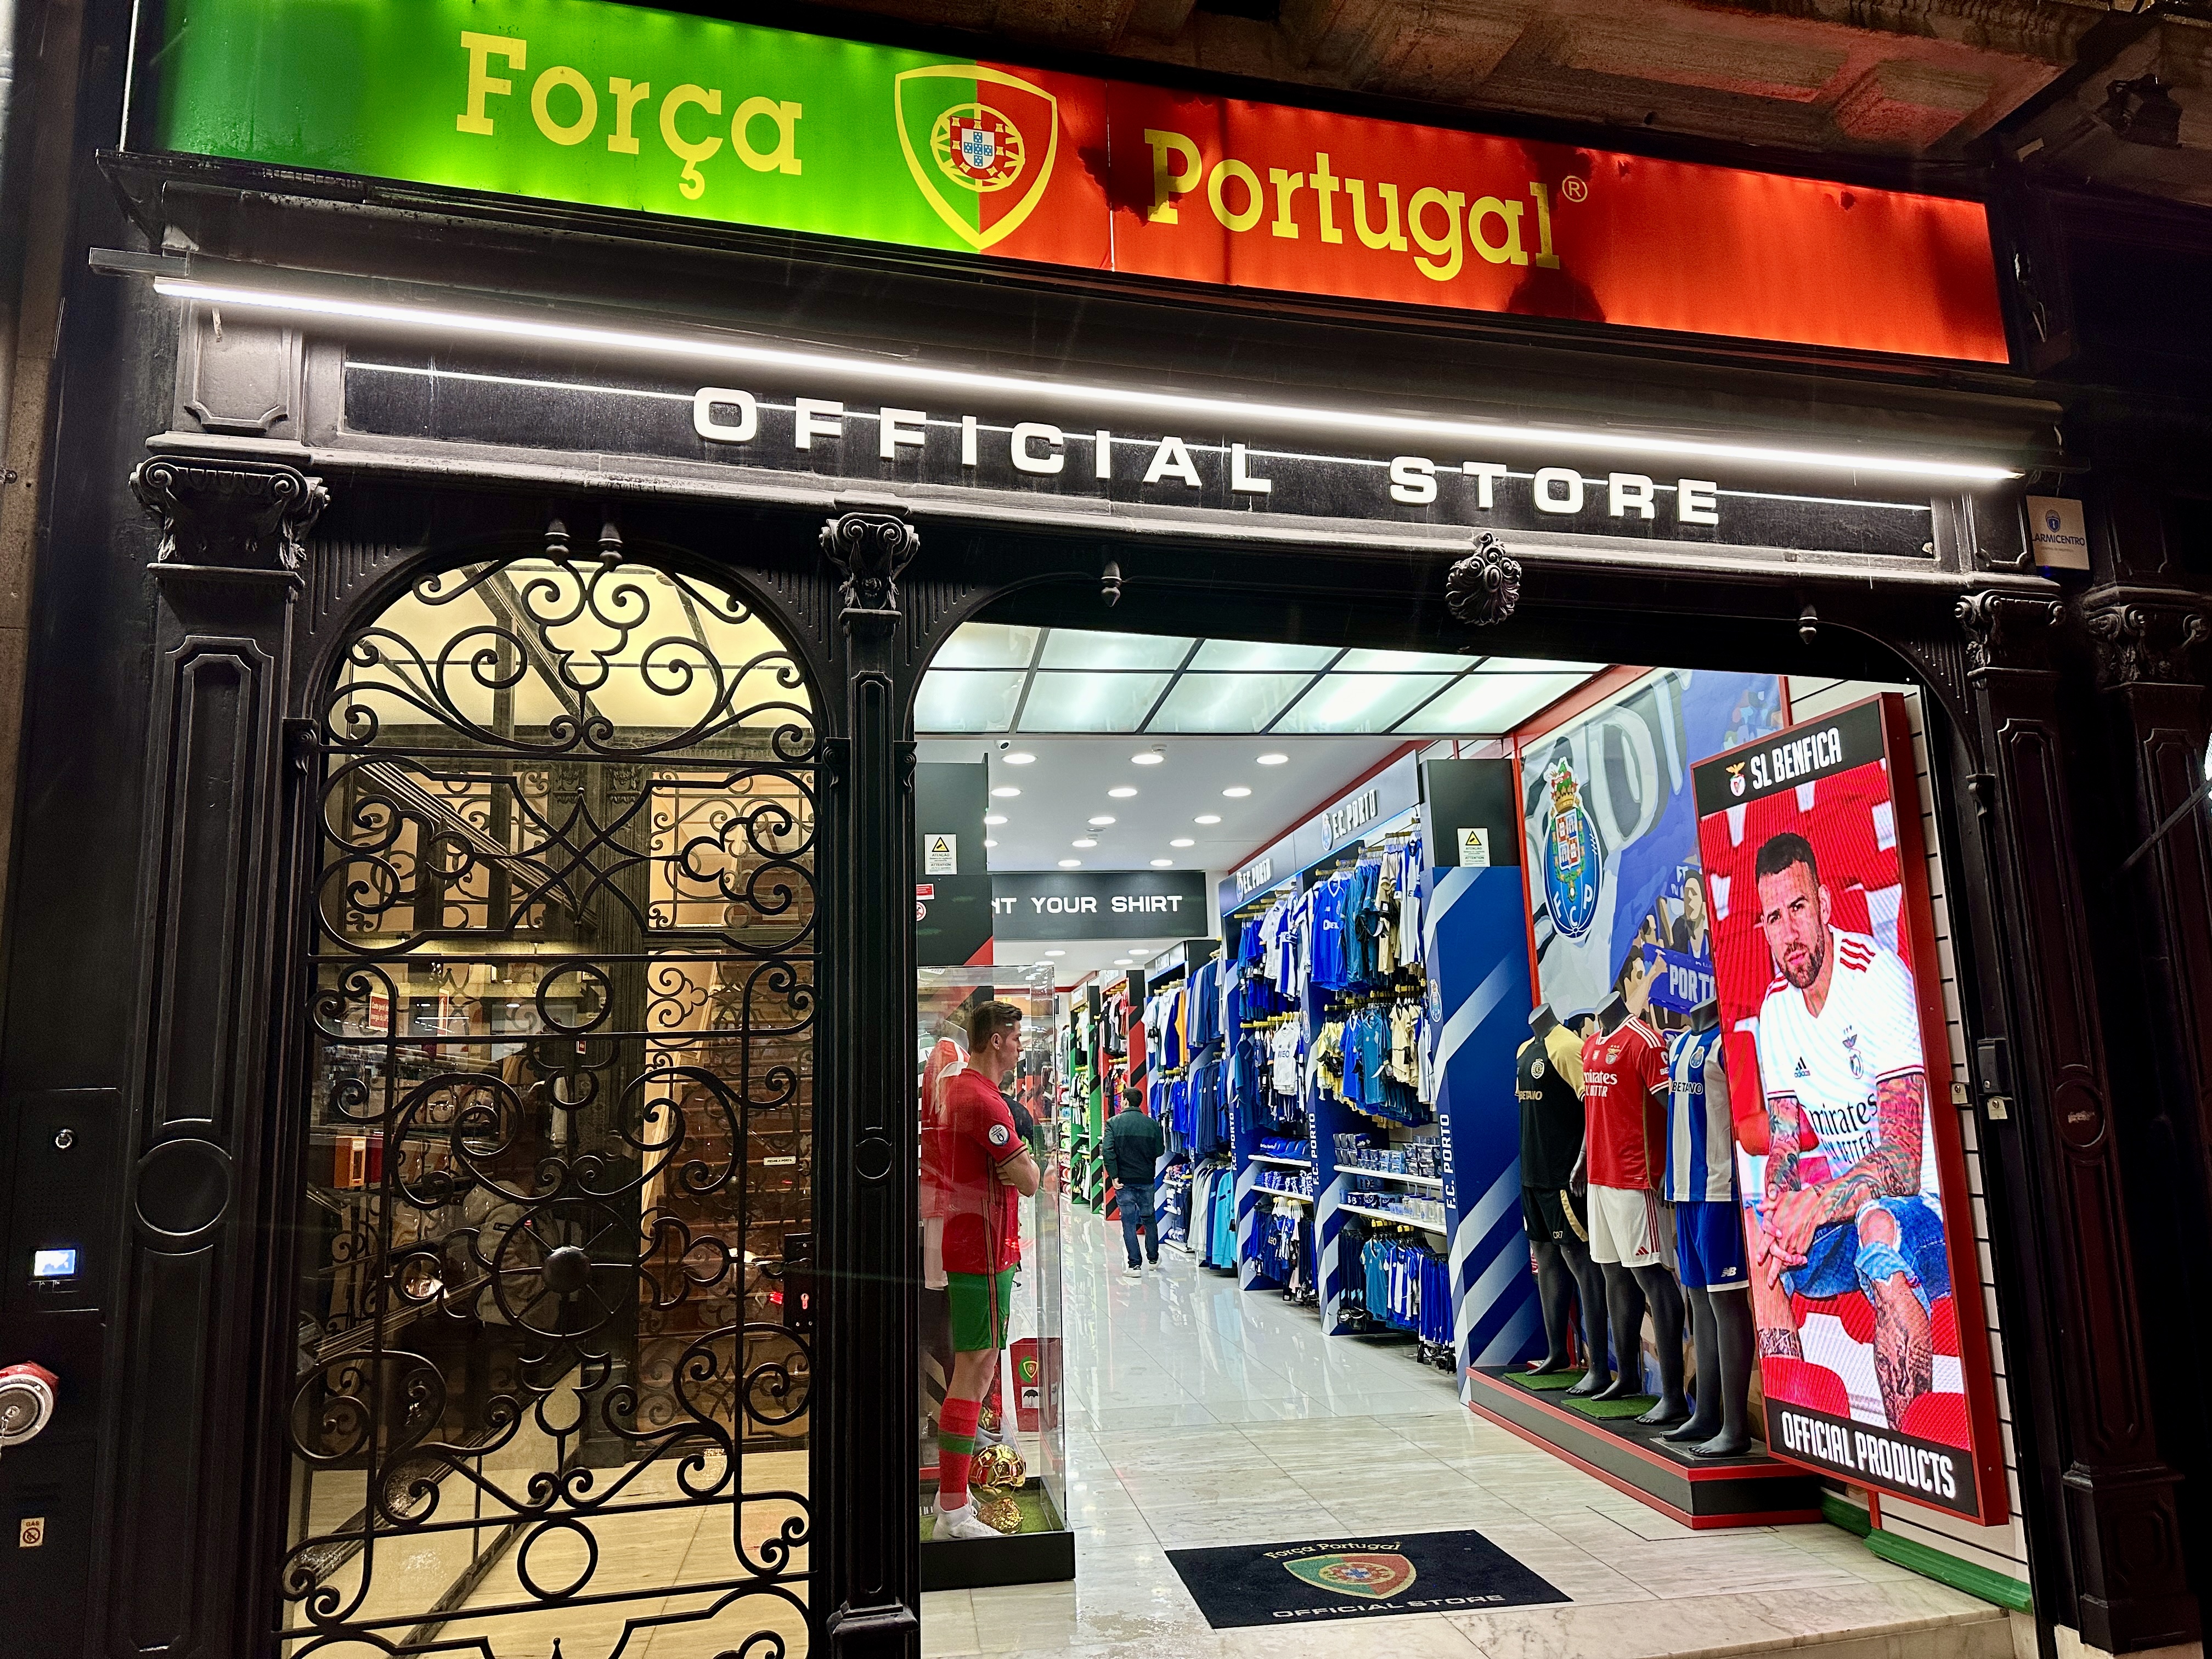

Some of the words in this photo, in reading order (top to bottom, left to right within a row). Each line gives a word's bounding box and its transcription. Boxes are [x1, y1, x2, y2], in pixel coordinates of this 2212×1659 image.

[456, 31, 802, 200] Força
[1143, 128, 1560, 281] Portugal
[693, 386, 1272, 494] OFFICIAL
[1389, 456, 1719, 525] STORE
[1750, 753, 1773, 790] SL
[1772, 726, 1842, 783] BENFICA
[1346, 789, 1378, 831] PORTO
[1030, 896, 1098, 913] YOUR
[1111, 895, 1183, 913] SHIRT
[1672, 1081, 1703, 1095] BETANO
[1802, 1093, 1878, 1136] mirates
[1308, 1113, 1318, 1159] PORTO
[1440, 1114, 1454, 1174] PORTO
[1445, 1180, 1457, 1210] F.C.
[1553, 1231, 1563, 1239] CR7
[1781, 1410, 1855, 1469] OFFICIAL
[1855, 1430, 1957, 1499] PRODUCTS
[1263, 1546, 1317, 1559] Força
[1316, 1542, 1401, 1550] Portugal
[1273, 1602, 1404, 1618] OFFICIAL
[1407, 1594, 1506, 1607] STORE
